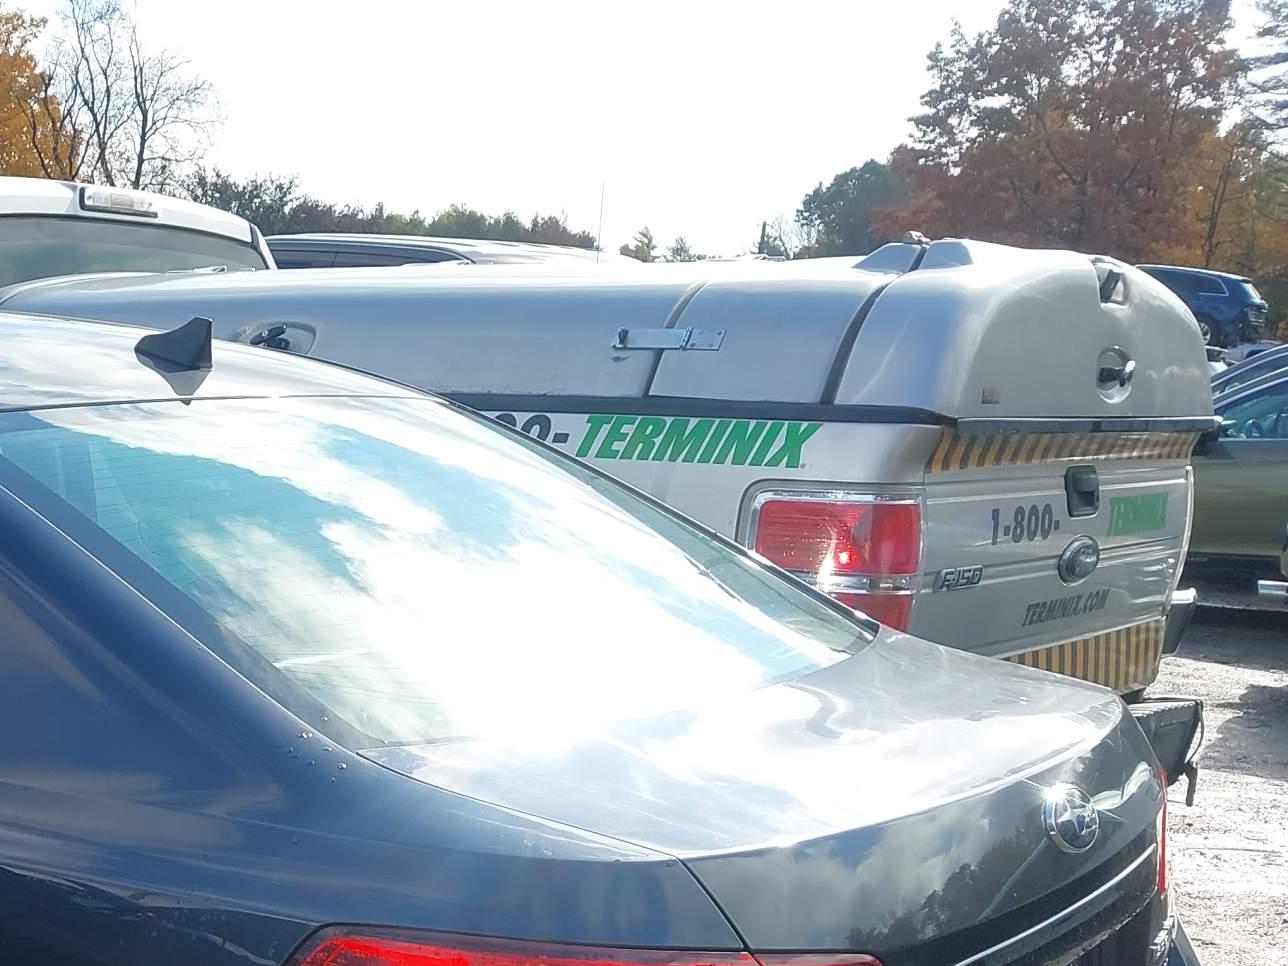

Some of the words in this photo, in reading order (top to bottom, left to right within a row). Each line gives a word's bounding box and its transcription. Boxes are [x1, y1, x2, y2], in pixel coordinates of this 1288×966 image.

[575, 414, 825, 469] TERMINIX
[991, 503, 1060, 546] 1-800-
[1021, 588, 1110, 627] TERMINIX.COM
